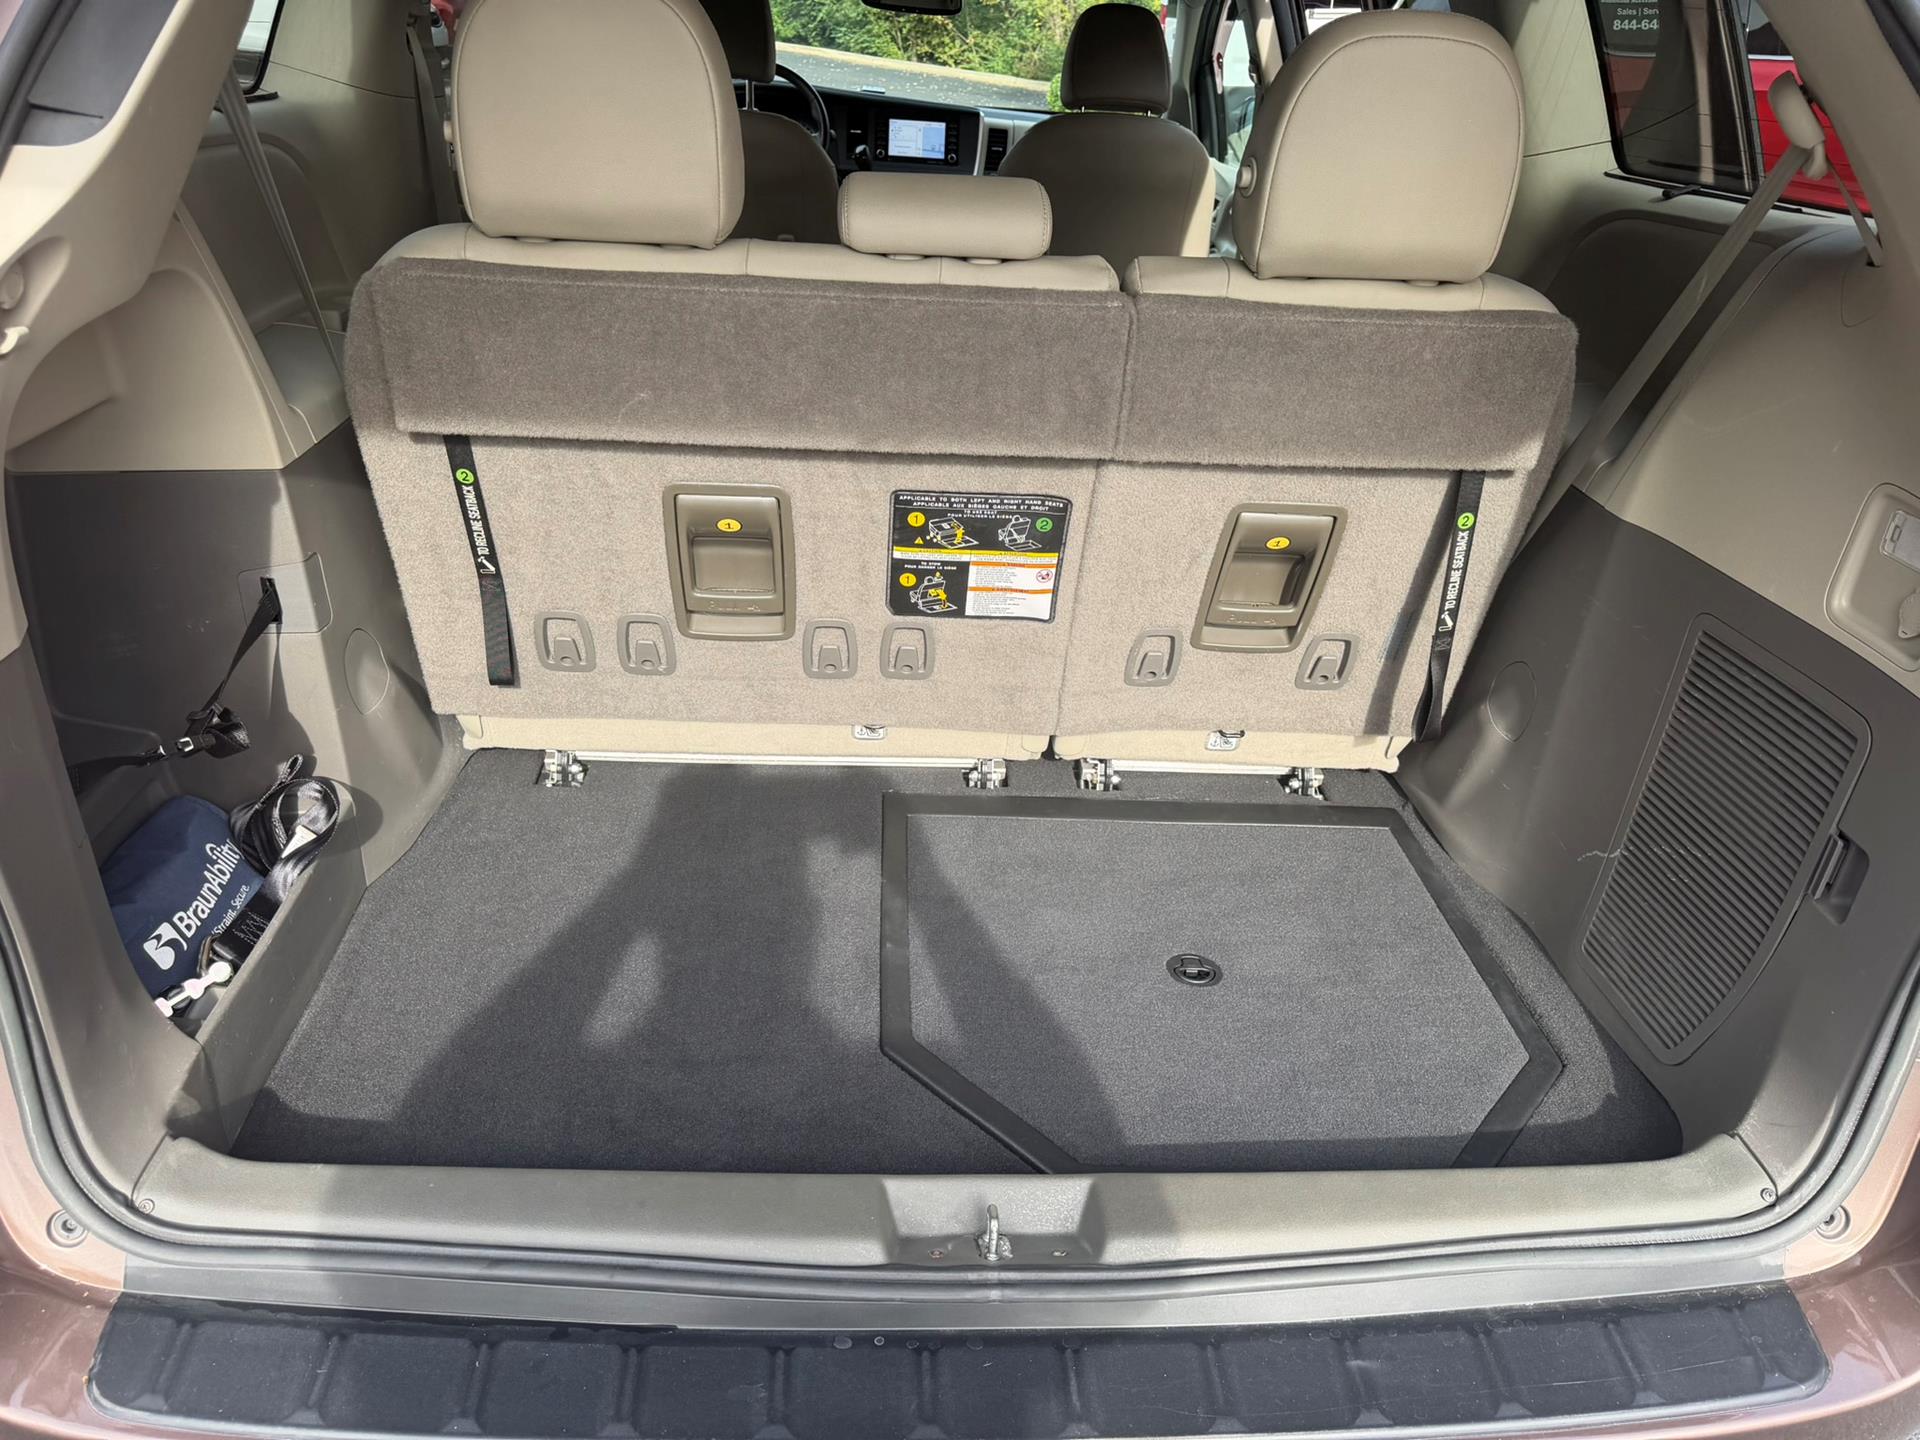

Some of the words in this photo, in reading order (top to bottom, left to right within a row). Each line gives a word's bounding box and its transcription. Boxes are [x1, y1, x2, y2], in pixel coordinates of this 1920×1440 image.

[1613, 19, 1660, 30] 844-64
[1616, 7, 1637, 15] Sales
[461, 485, 481, 520] SEATBACK
[1044, 500, 1064, 508] SEATS
[470, 519, 488, 547] RECLINE
[1452, 530, 1470, 569] SEATBACK
[1446, 569, 1462, 600] RECLINE
[1445, 600, 1457, 611] TO
[172, 838, 245, 939] BraunAbility
